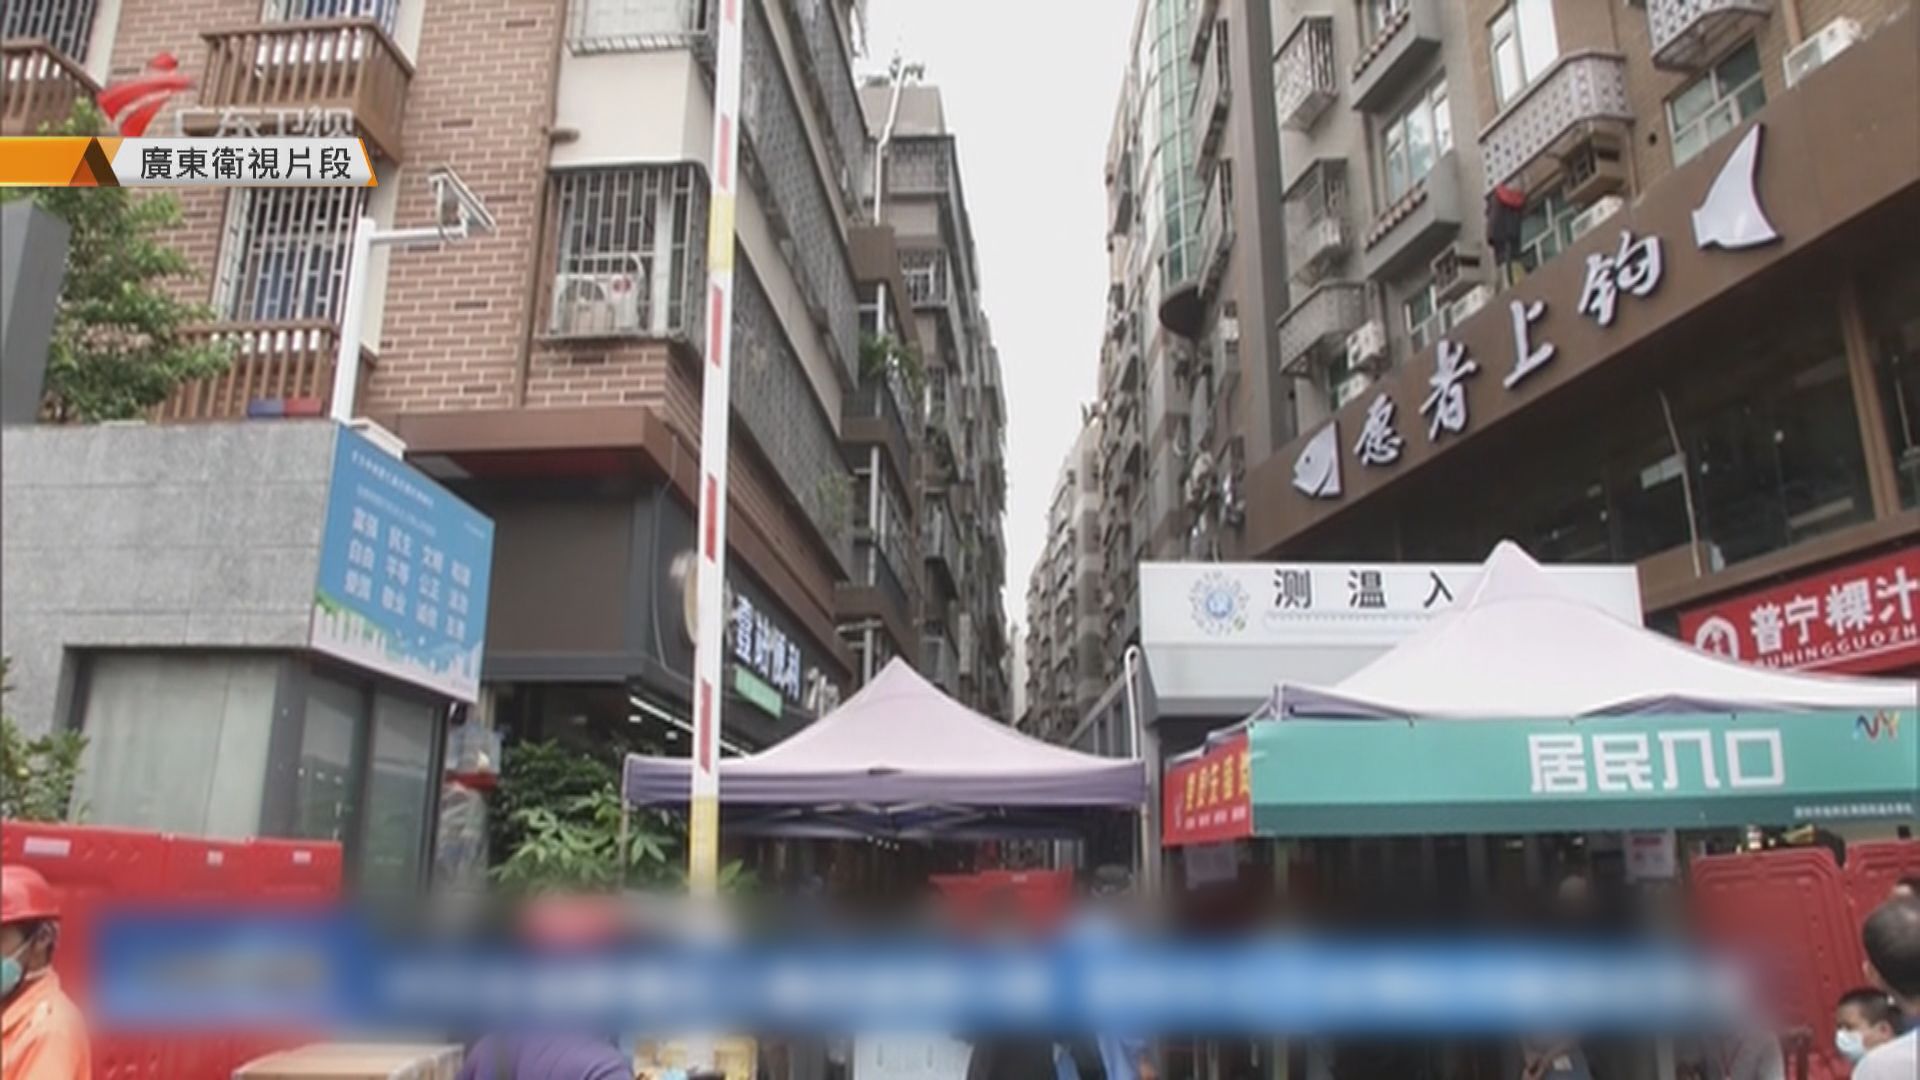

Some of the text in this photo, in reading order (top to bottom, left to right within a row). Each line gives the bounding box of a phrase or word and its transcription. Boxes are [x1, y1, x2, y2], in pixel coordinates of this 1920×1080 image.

[1274, 568, 1453, 609] 测温入
[1750, 566, 1919, 655] 普宁粿汁
[1528, 728, 1785, 793] 居民入口
